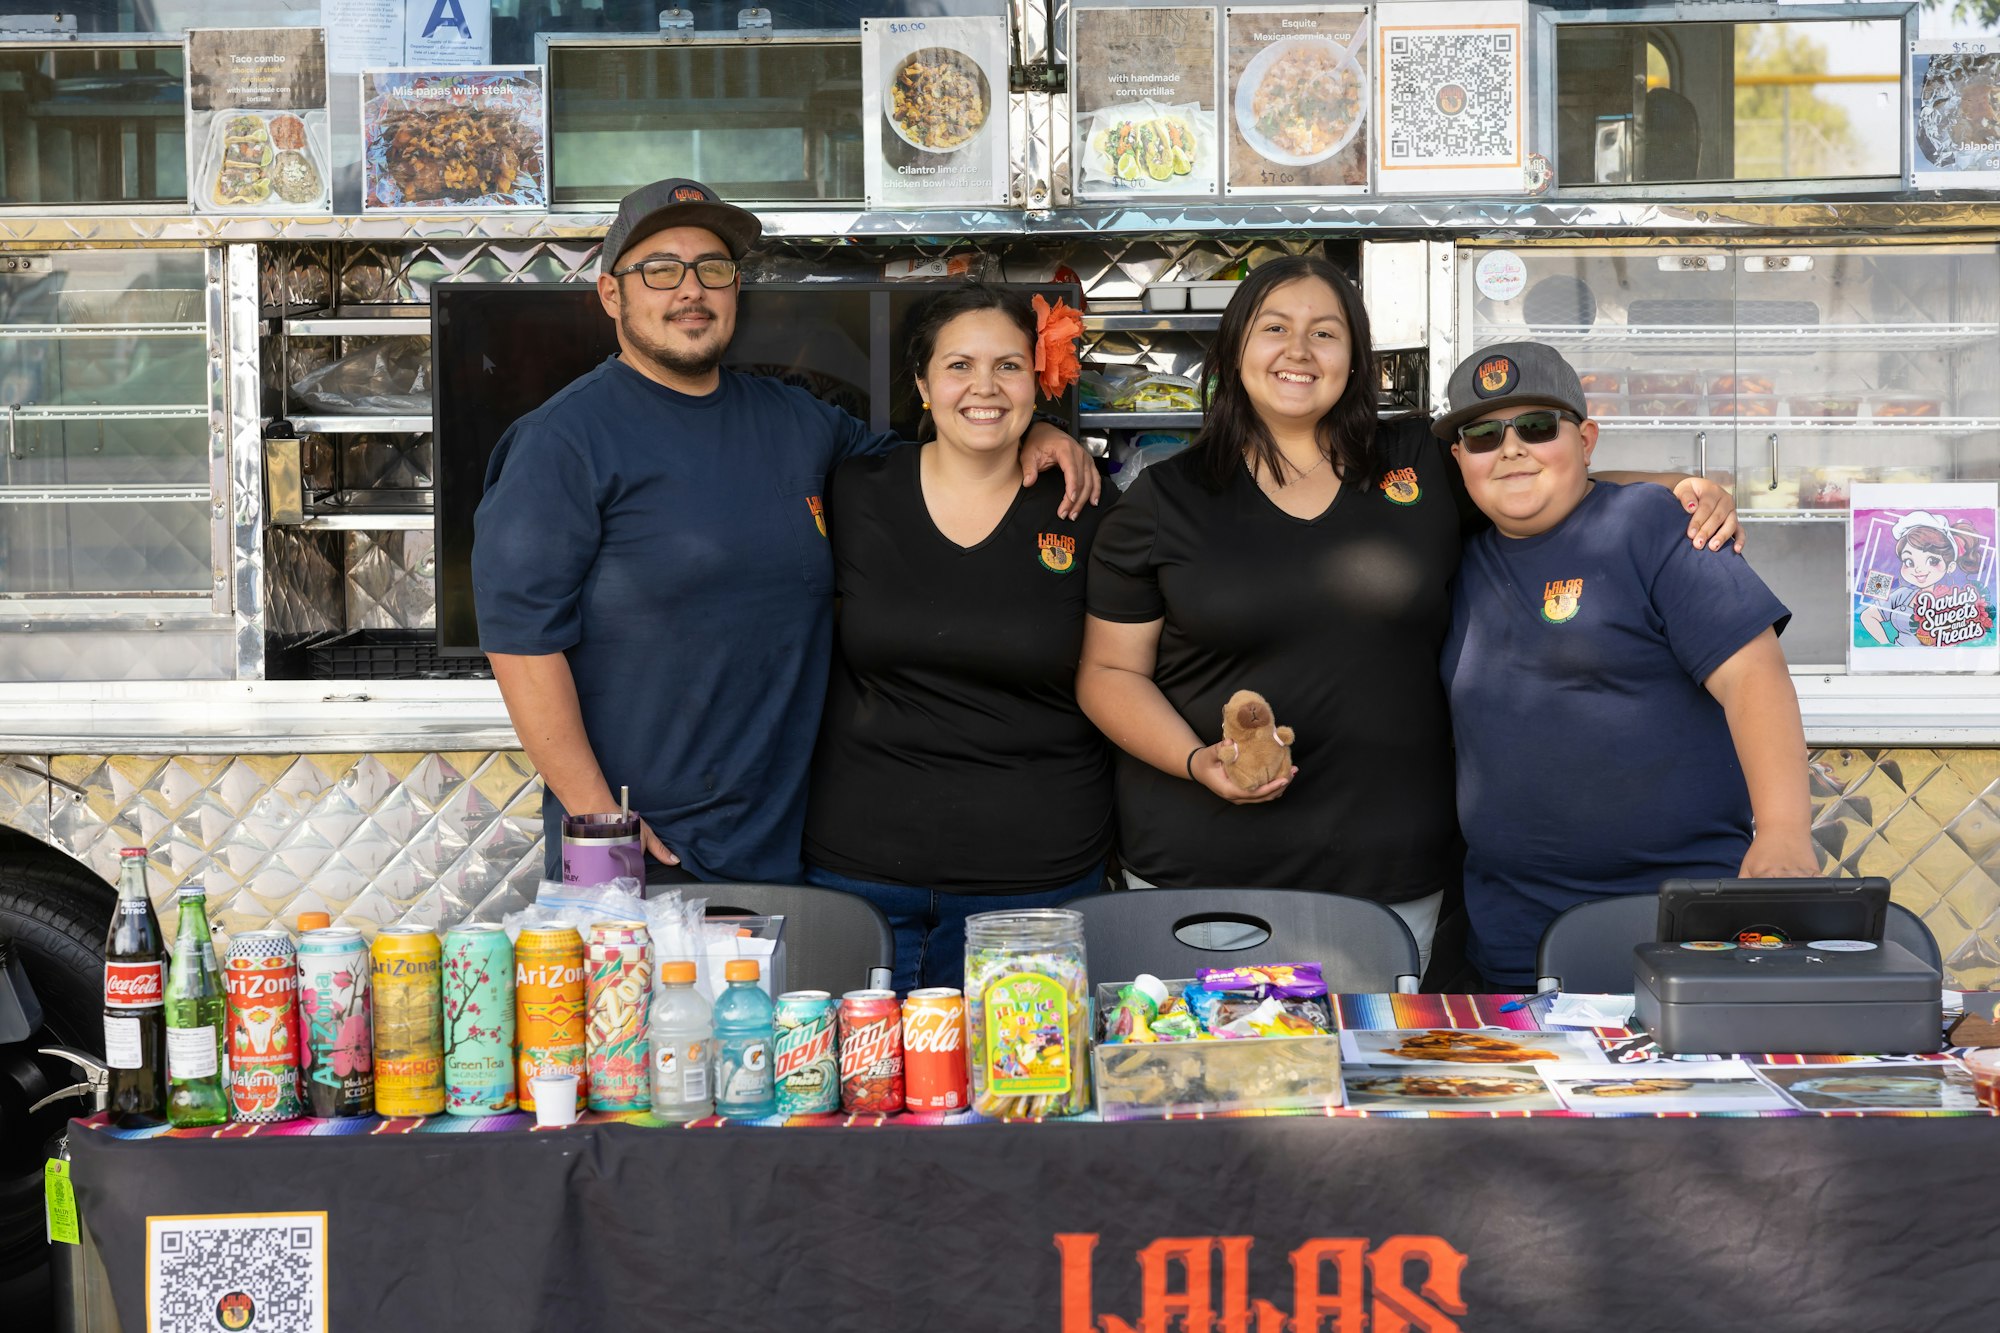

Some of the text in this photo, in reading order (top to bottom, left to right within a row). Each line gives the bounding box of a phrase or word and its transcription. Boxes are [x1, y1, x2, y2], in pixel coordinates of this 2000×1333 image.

[421, 0, 472, 38] A
[1281, 19, 1317, 29] Esquite
[890, 22, 926, 33] $10.00
[1253, 33, 1291, 41] Mexican
[1334, 33, 1351, 41] cup
[1952, 42, 1986, 54] $5.00
[230, 54, 286, 63] Taco combo
[1108, 73, 1180, 83] with handmade
[227, 86, 241, 94] with
[241, 85, 275, 93] handmade
[393, 84, 514, 97] Mis papas with steak
[1116, 86, 1175, 96] corn tortillas
[1958, 141, 2000, 152] Jalapeñ
[898, 164, 978, 175] Cilantro lime rice
[1986, 159, 2000, 169] eg
[884, 178, 992, 189] chicken bowl with corn
[1479, 359, 1508, 378] LALAS
[1380, 467, 1417, 490] LALAS
[1038, 532, 1076, 554] LALAS
[1543, 578, 1584, 601] LALAS
[1917, 586, 1977, 616] Darla's
[1922, 603, 1978, 631] Sweets
[1951, 618, 1967, 630] and
[1930, 620, 1984, 648] Treats
[120, 907, 147, 915] LITRO
[371, 956, 436, 976] AriZona
[516, 962, 585, 988] AriZon
[107, 973, 159, 995] Coca-Cola
[312, 972, 342, 1089] AriZona
[449, 1056, 504, 1070] Green Tea
[868, 1063, 901, 1076] RED
[231, 1068, 299, 1087] Watermelon
[1053, 1233, 1468, 1333] LALAS
